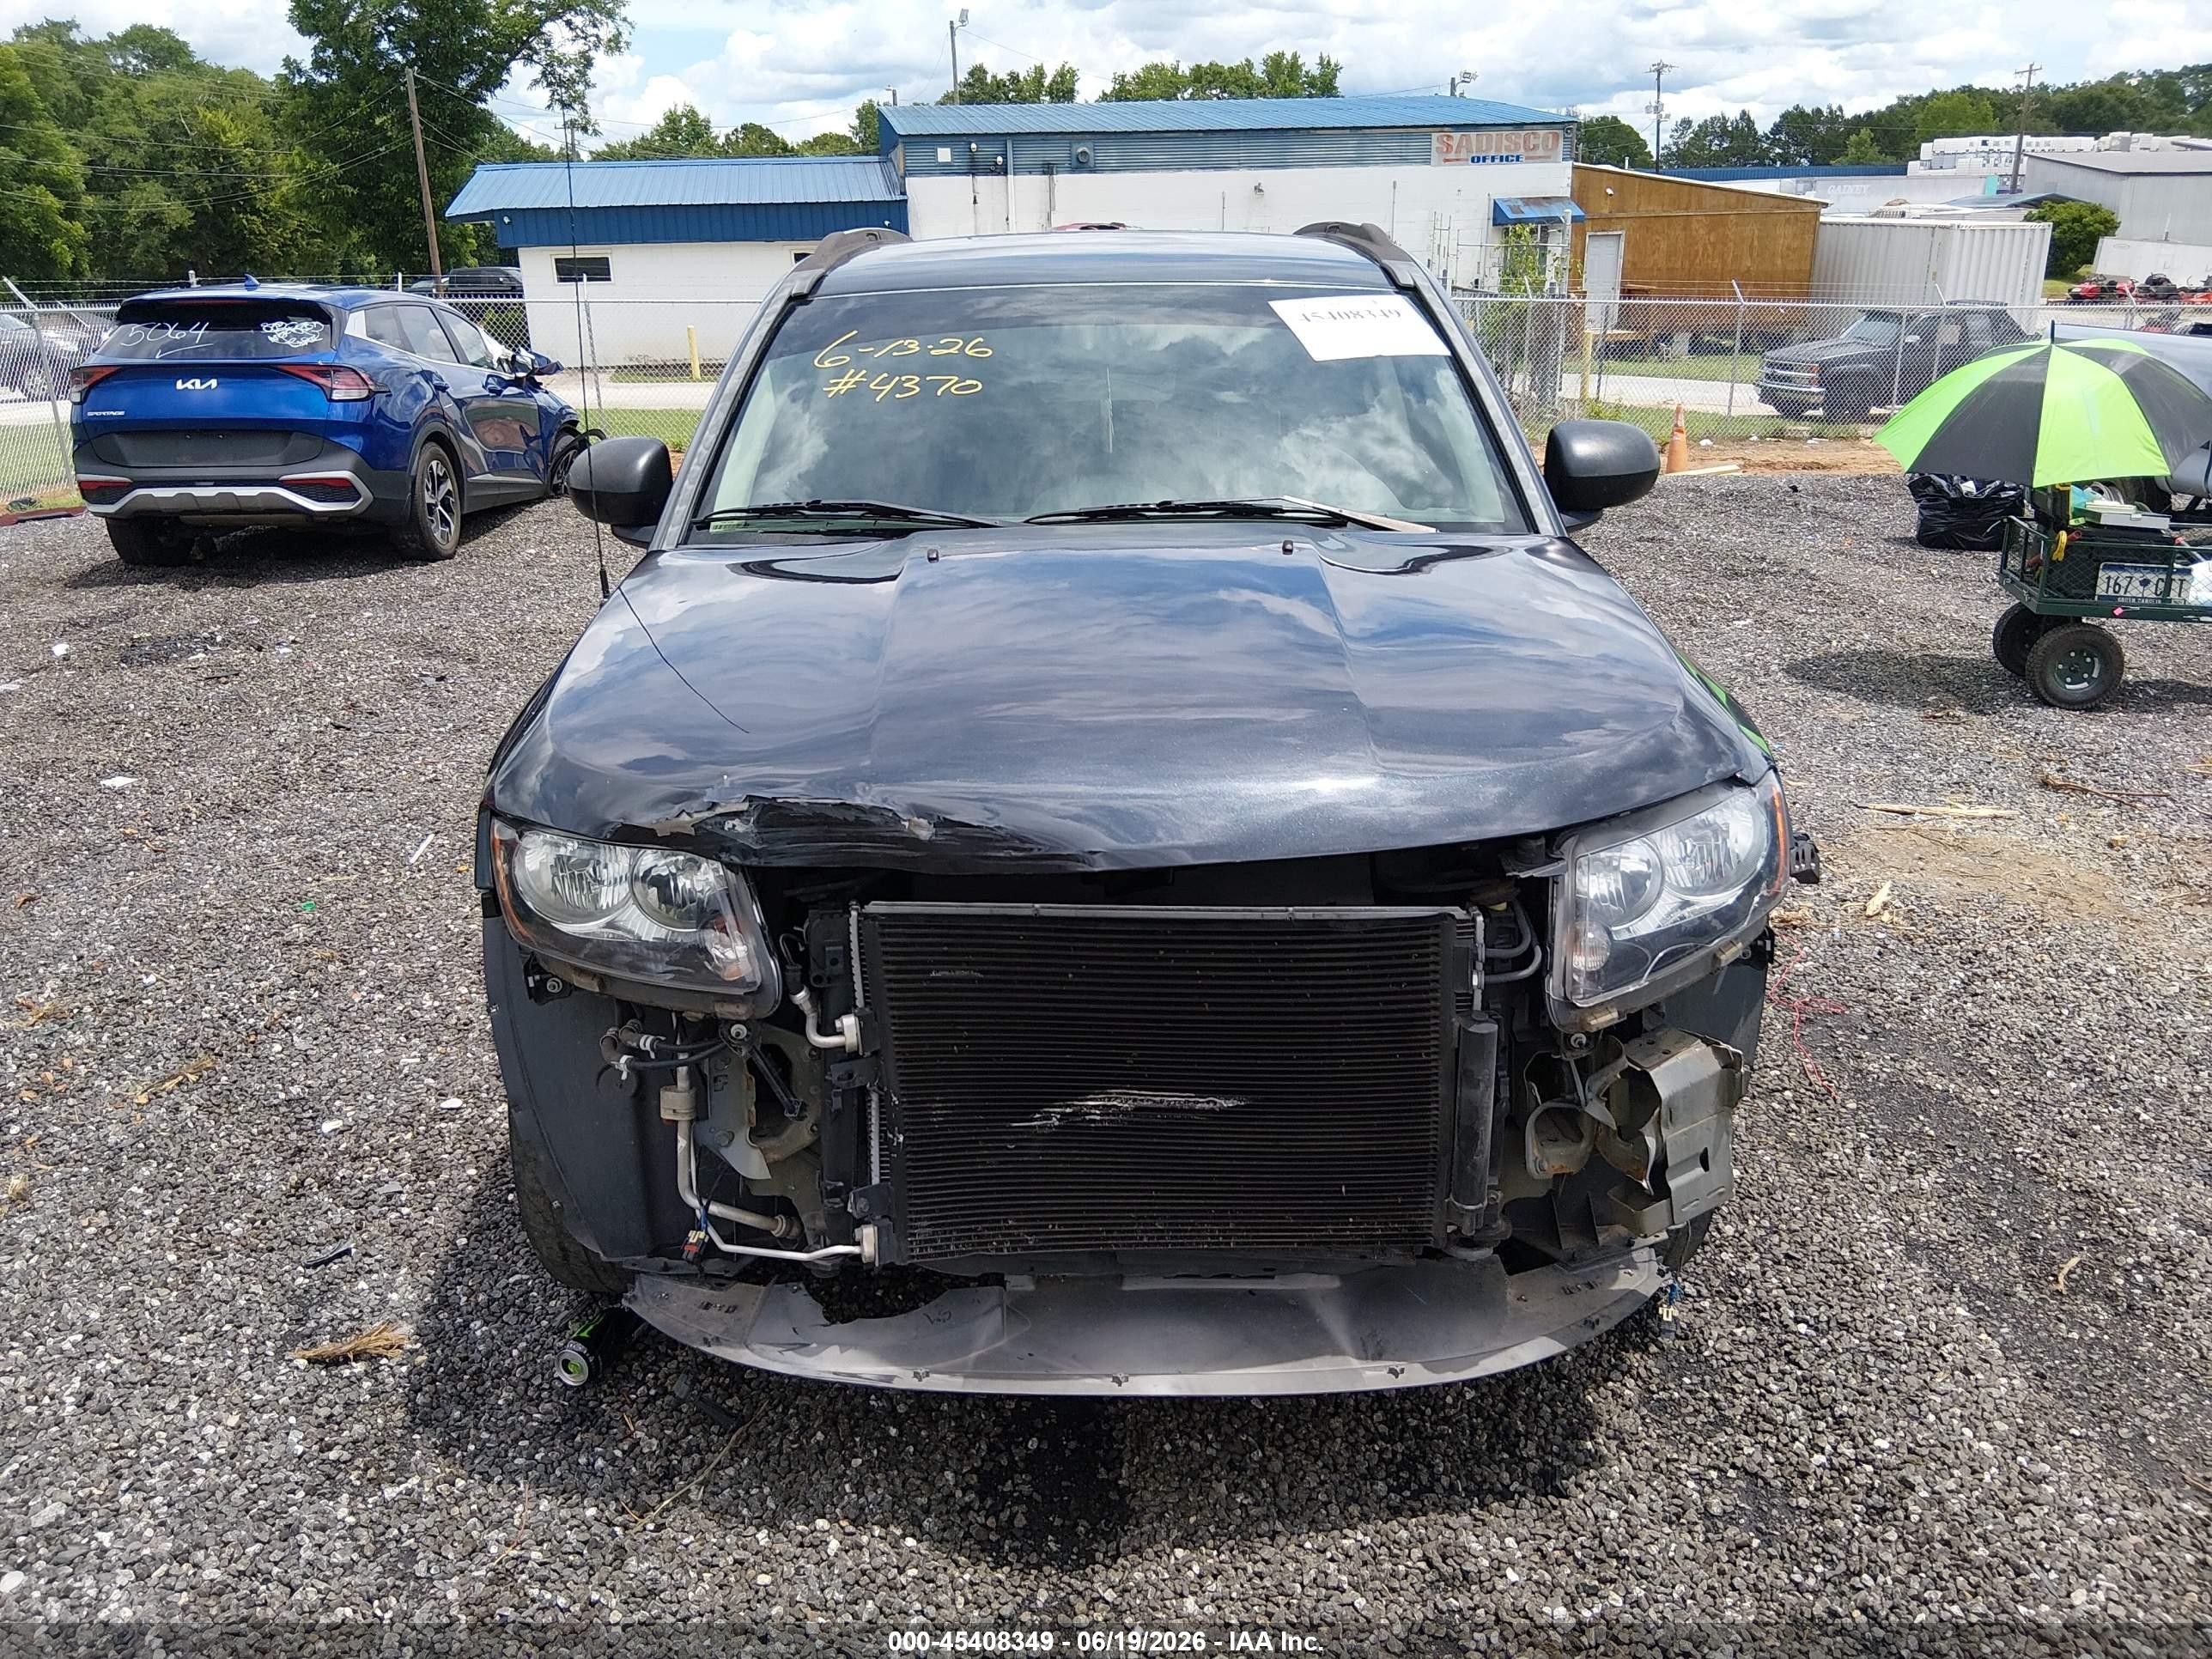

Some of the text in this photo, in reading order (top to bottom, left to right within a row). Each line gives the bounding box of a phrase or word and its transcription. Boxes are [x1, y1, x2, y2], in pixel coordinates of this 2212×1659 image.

[1436, 131, 1560, 155] SADISCO
[1470, 155, 1525, 164] OFFICE
[120, 321, 210, 347] 5064
[176, 379, 218, 390] KIA
[823, 368, 983, 402] #4370
[2105, 575, 2134, 594] 167
